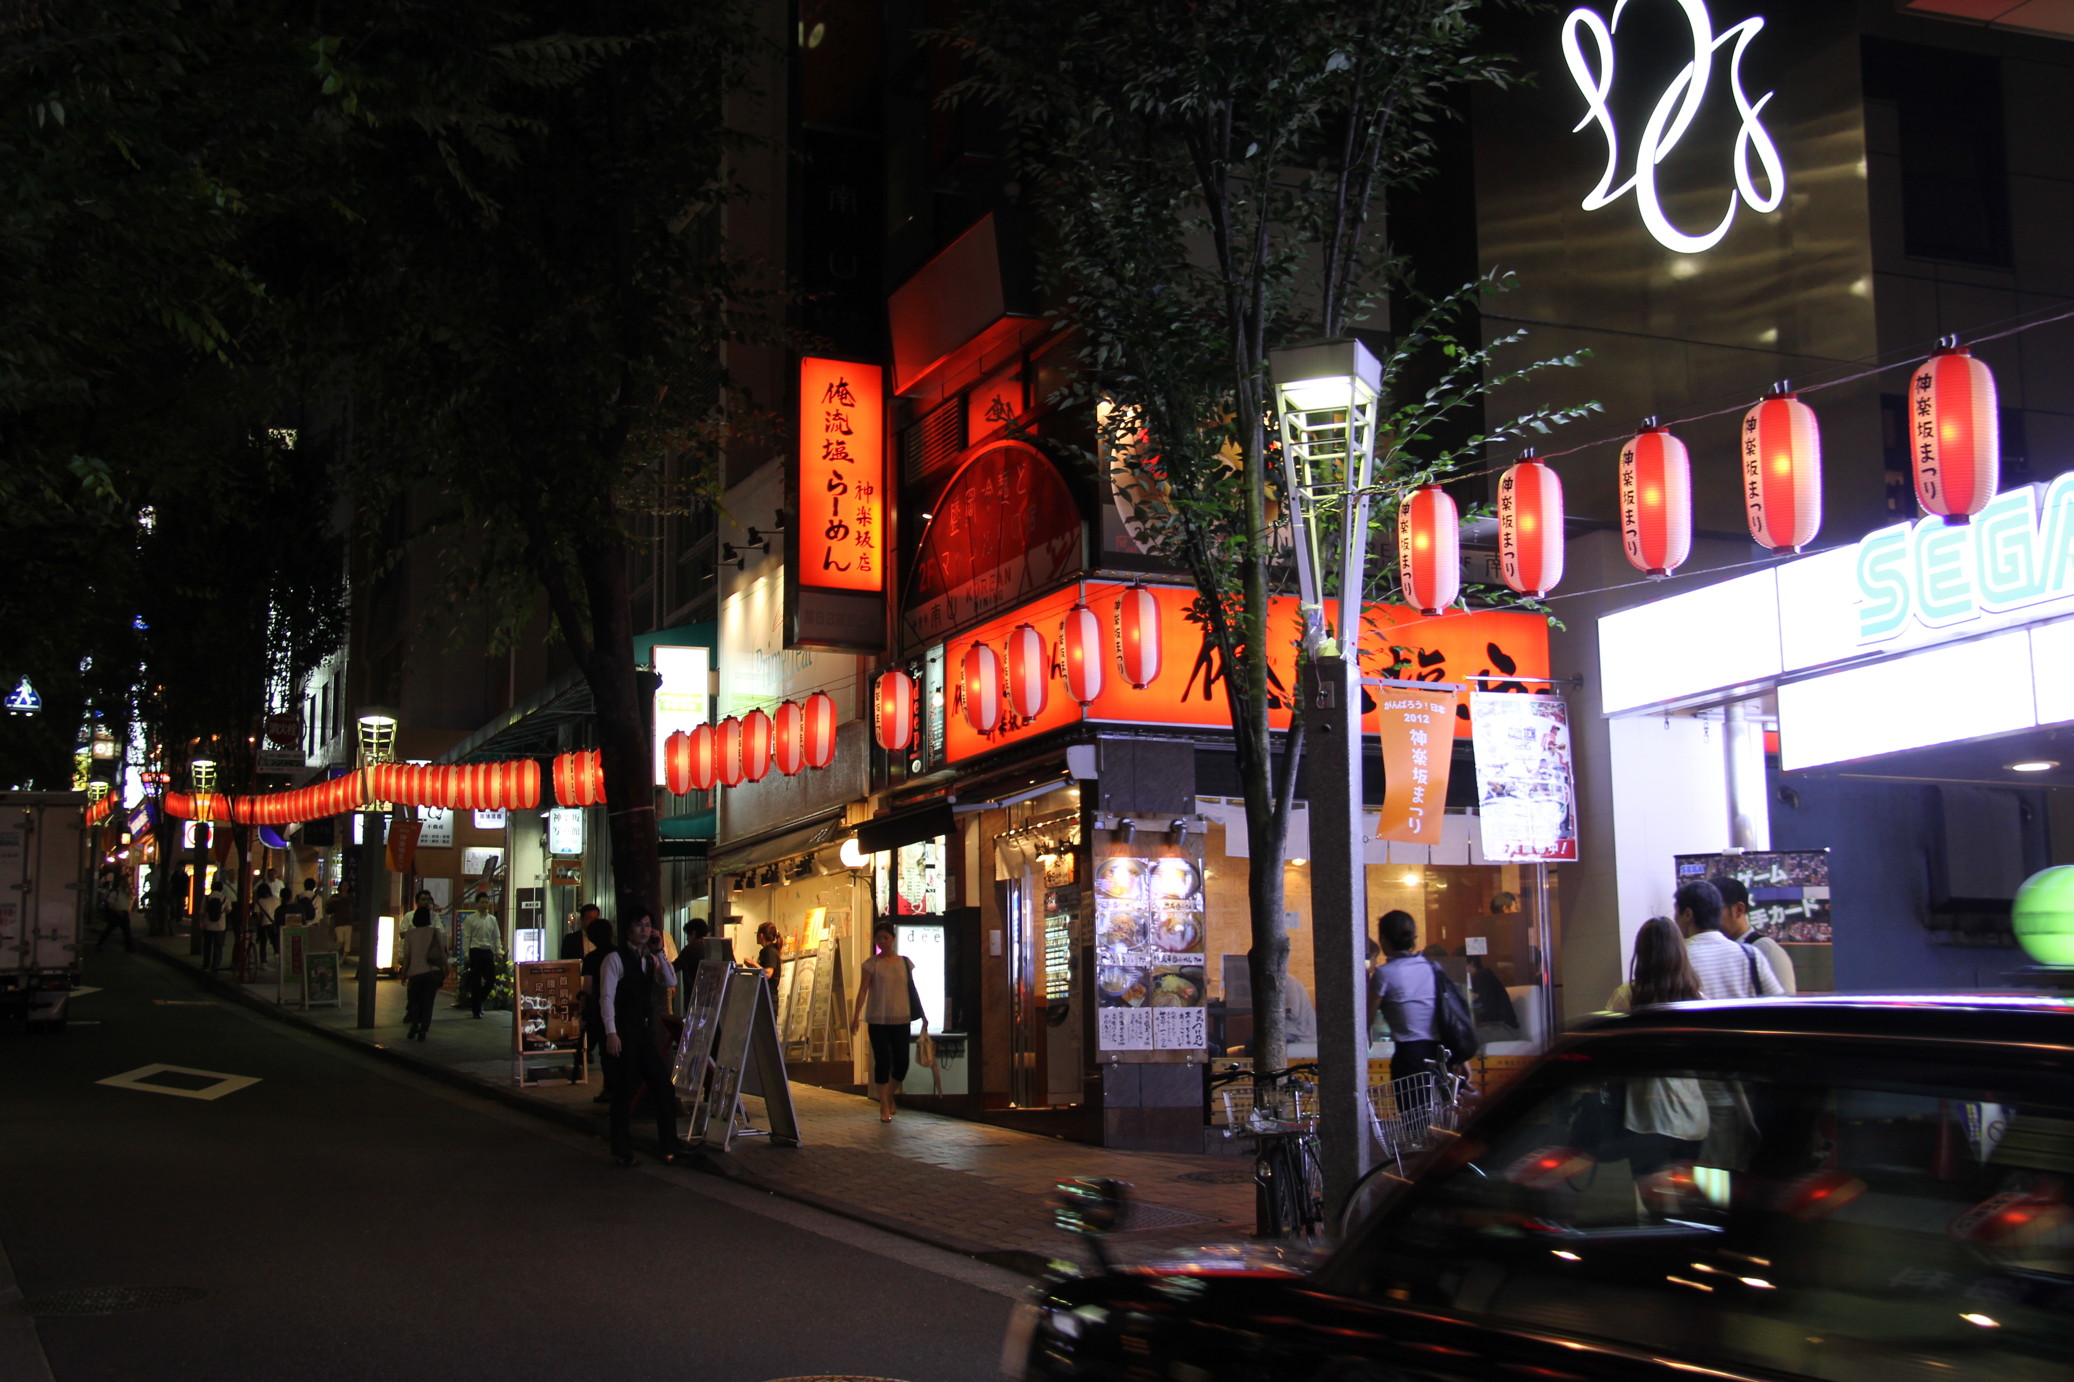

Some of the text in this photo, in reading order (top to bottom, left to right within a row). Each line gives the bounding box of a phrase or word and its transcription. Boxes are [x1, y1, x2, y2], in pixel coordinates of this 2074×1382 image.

[822, 377, 856, 572] 俺流塩らーめん
[1744, 415, 1761, 533] 神楽坂まつり
[1915, 372, 1938, 500] 神楽坂まつり
[854, 481, 875, 572] 神楽坂店
[1400, 503, 1412, 597] 神楽坂まつり
[1501, 477, 1515, 578] 神楽坂まつり
[1623, 450, 1638, 556] 神楽坂まつり
[966, 567, 1011, 599] KOREAN
[1403, 713, 1431, 724] 2012
[1407, 728, 1429, 834] 神楽坂まつり
[1730, 864, 1788, 889] ゲーム
[1747, 897, 1821, 930] 手カード
